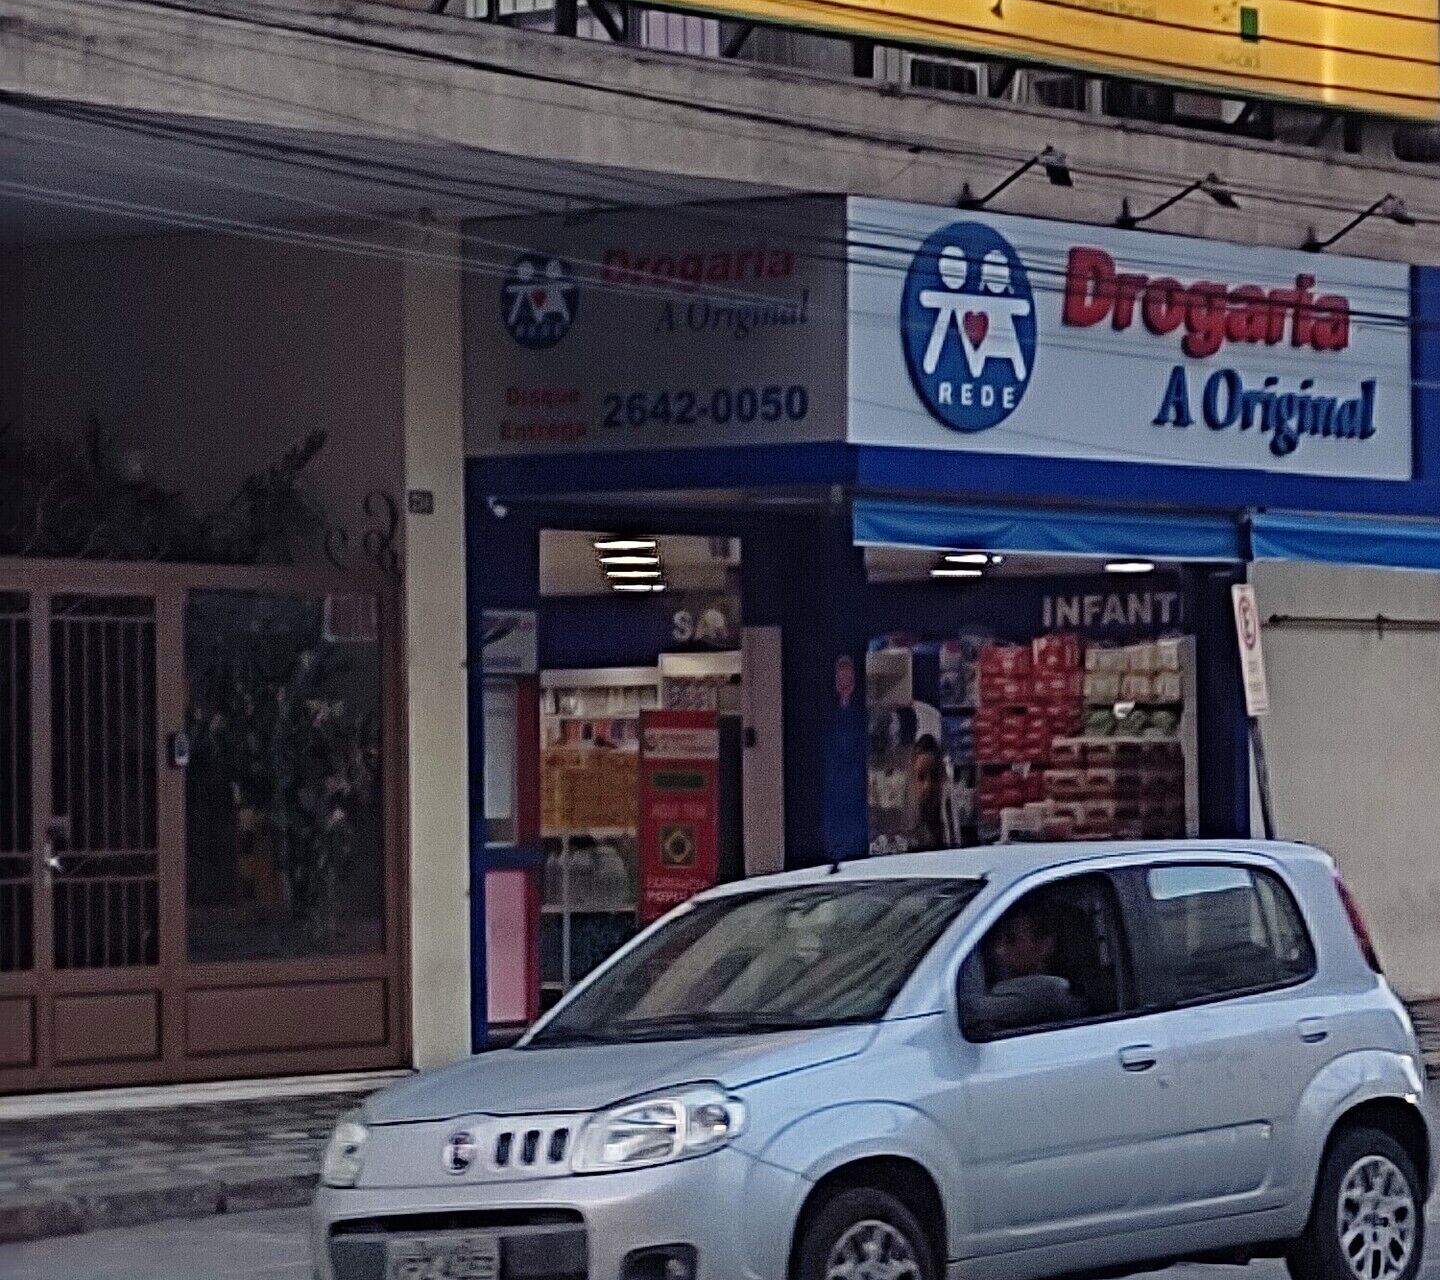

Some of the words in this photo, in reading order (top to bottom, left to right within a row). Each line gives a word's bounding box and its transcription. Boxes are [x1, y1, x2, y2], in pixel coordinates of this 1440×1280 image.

[601, 247, 795, 292] Drogaria
[1061, 244, 1350, 359] Drogaria
[603, 384, 809, 428] 2642-0050
[938, 381, 1015, 409] REDE
[1153, 365, 1194, 428] A
[1202, 367, 1377, 458] Original
[1042, 591, 1184, 628] INFANT
